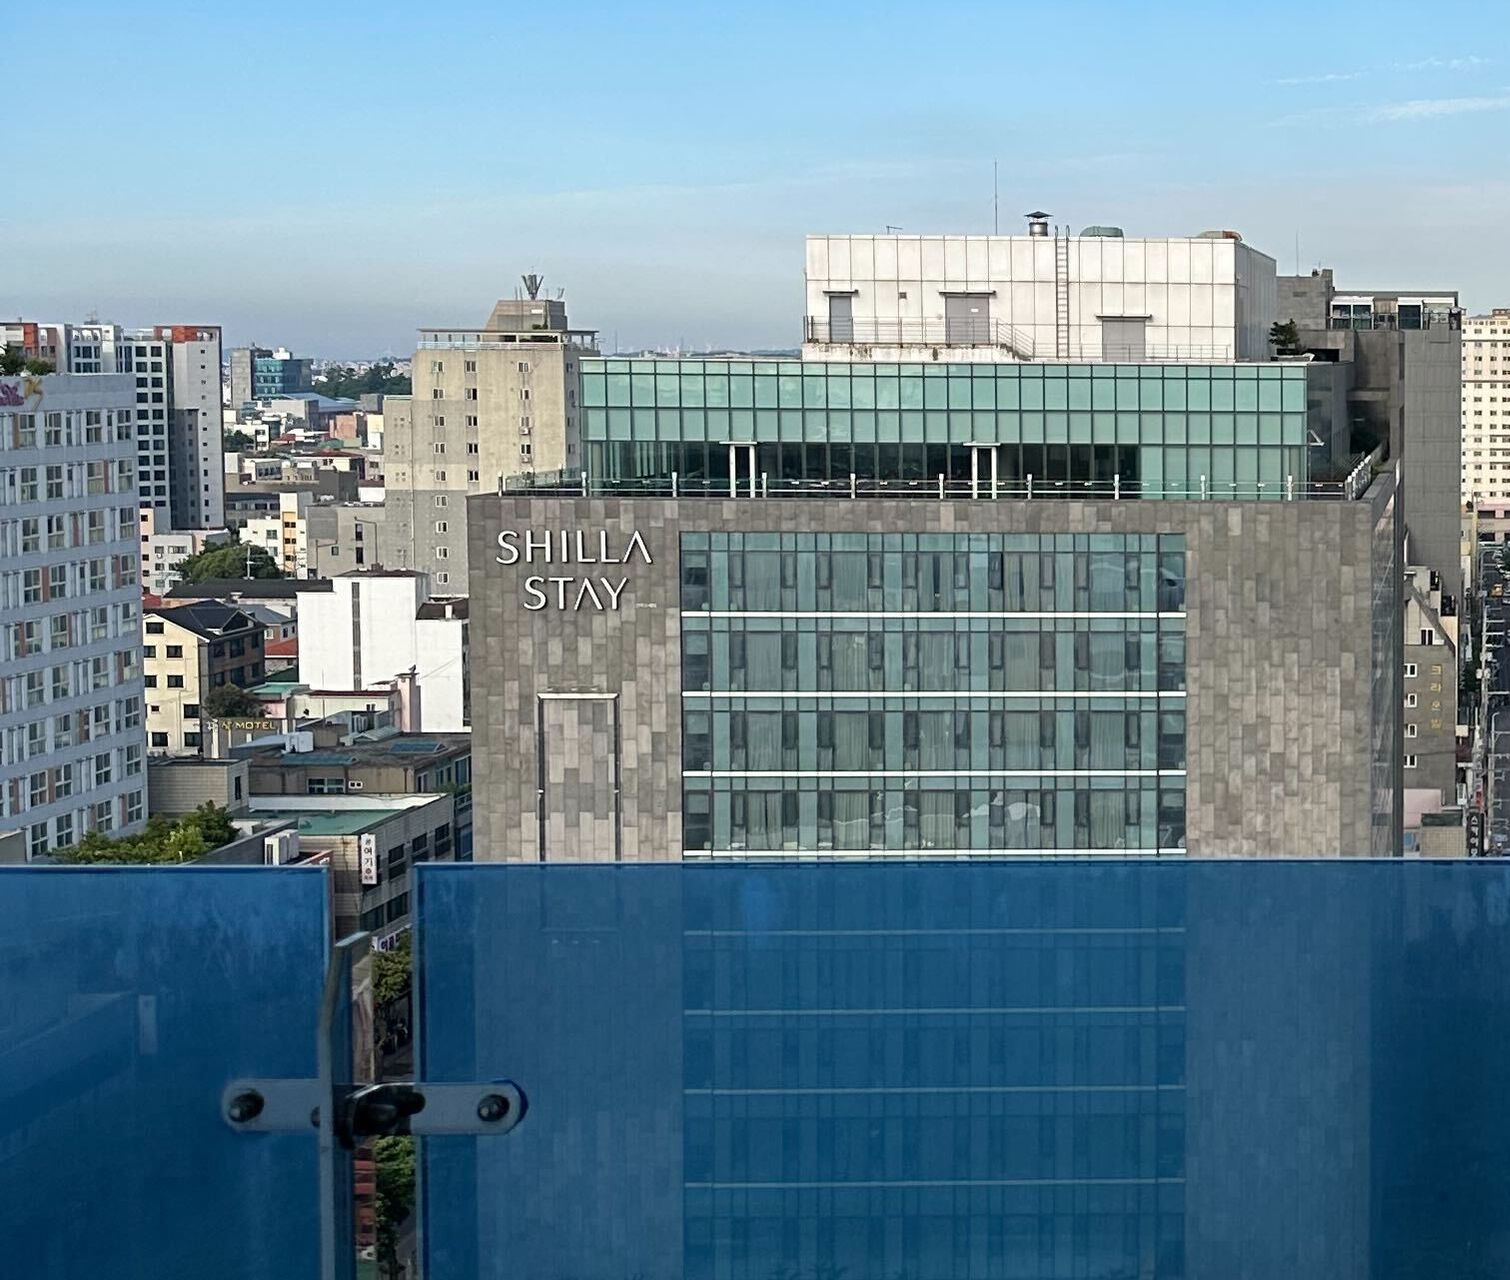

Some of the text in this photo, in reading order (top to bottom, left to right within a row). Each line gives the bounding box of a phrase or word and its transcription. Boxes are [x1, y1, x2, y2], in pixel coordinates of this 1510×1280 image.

[494, 528, 654, 565] SHILLA
[522, 575, 629, 612] STAY
[235, 721, 277, 731] MOTEL
